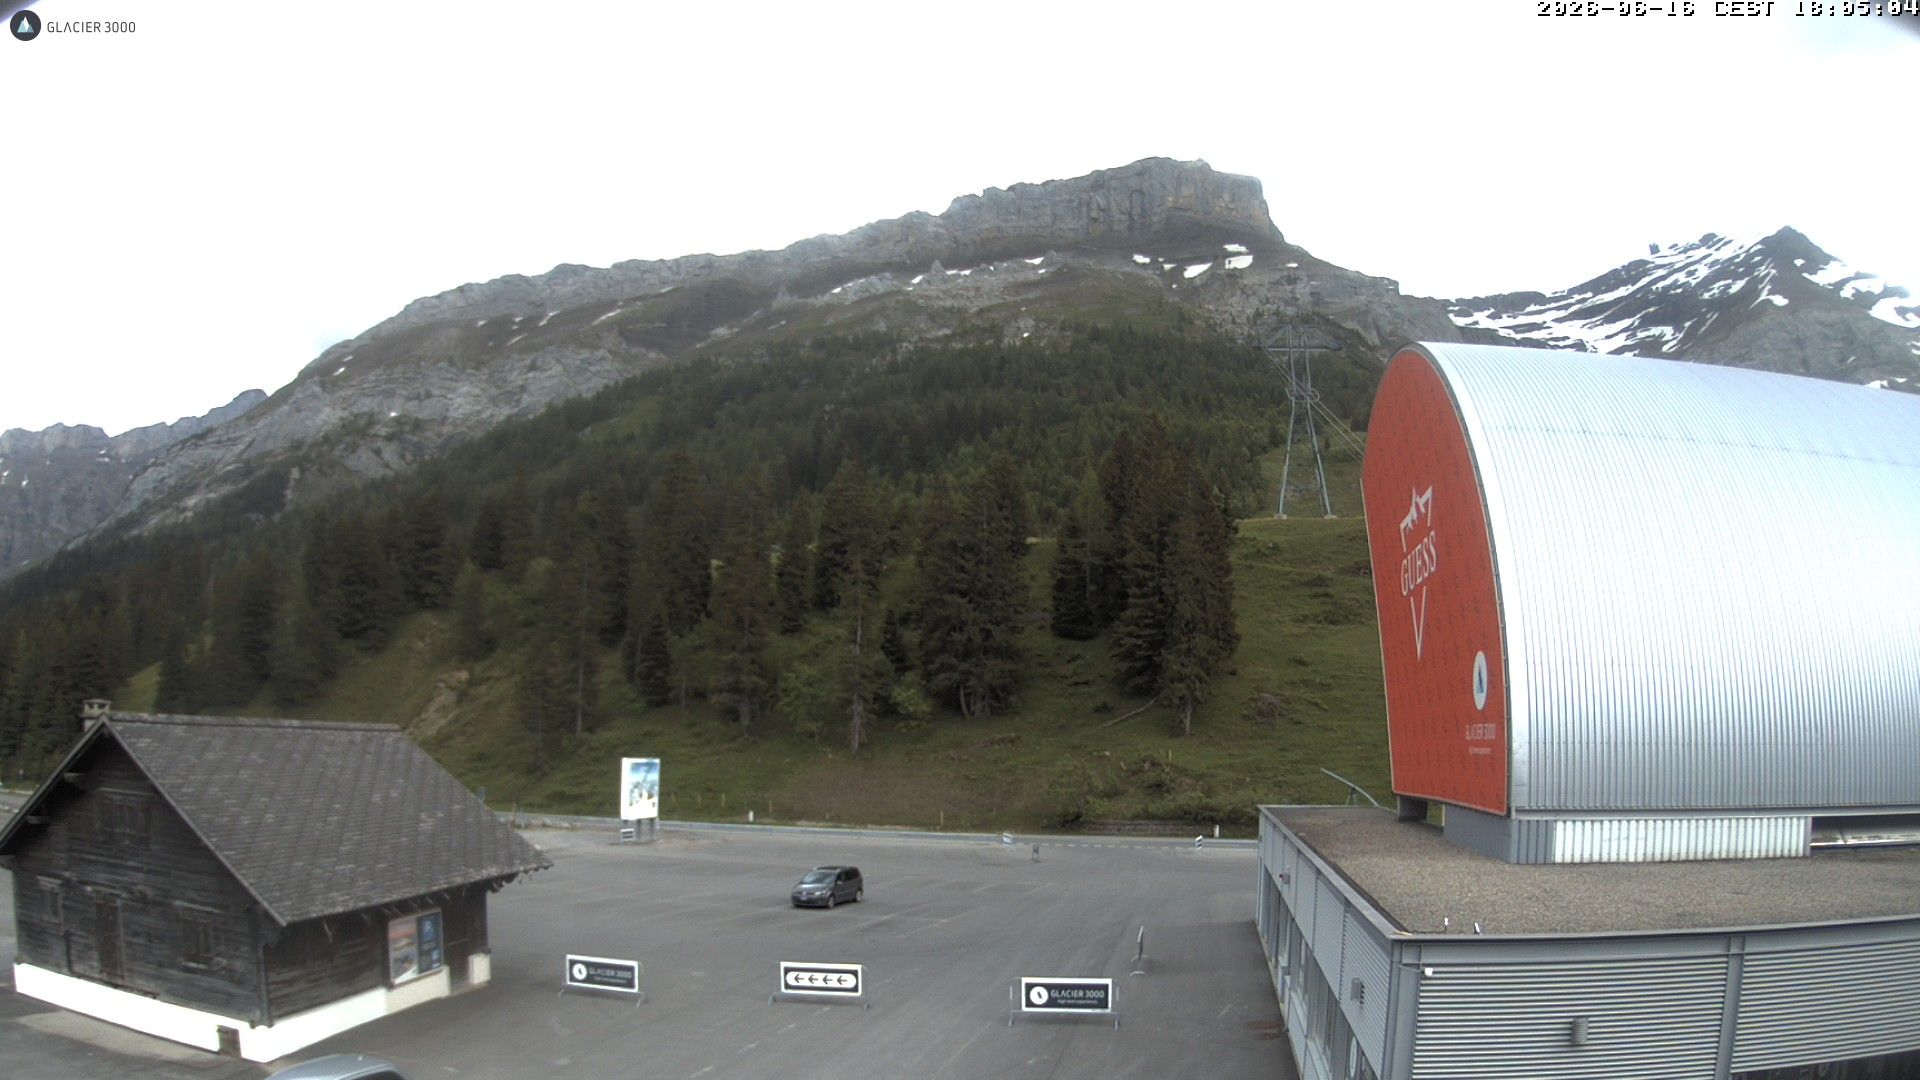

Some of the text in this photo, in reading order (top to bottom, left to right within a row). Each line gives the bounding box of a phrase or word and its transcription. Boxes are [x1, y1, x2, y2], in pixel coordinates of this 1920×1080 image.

[1400, 530, 1437, 596] GUESS
[1050, 989, 1105, 998] GLACIER 3000
